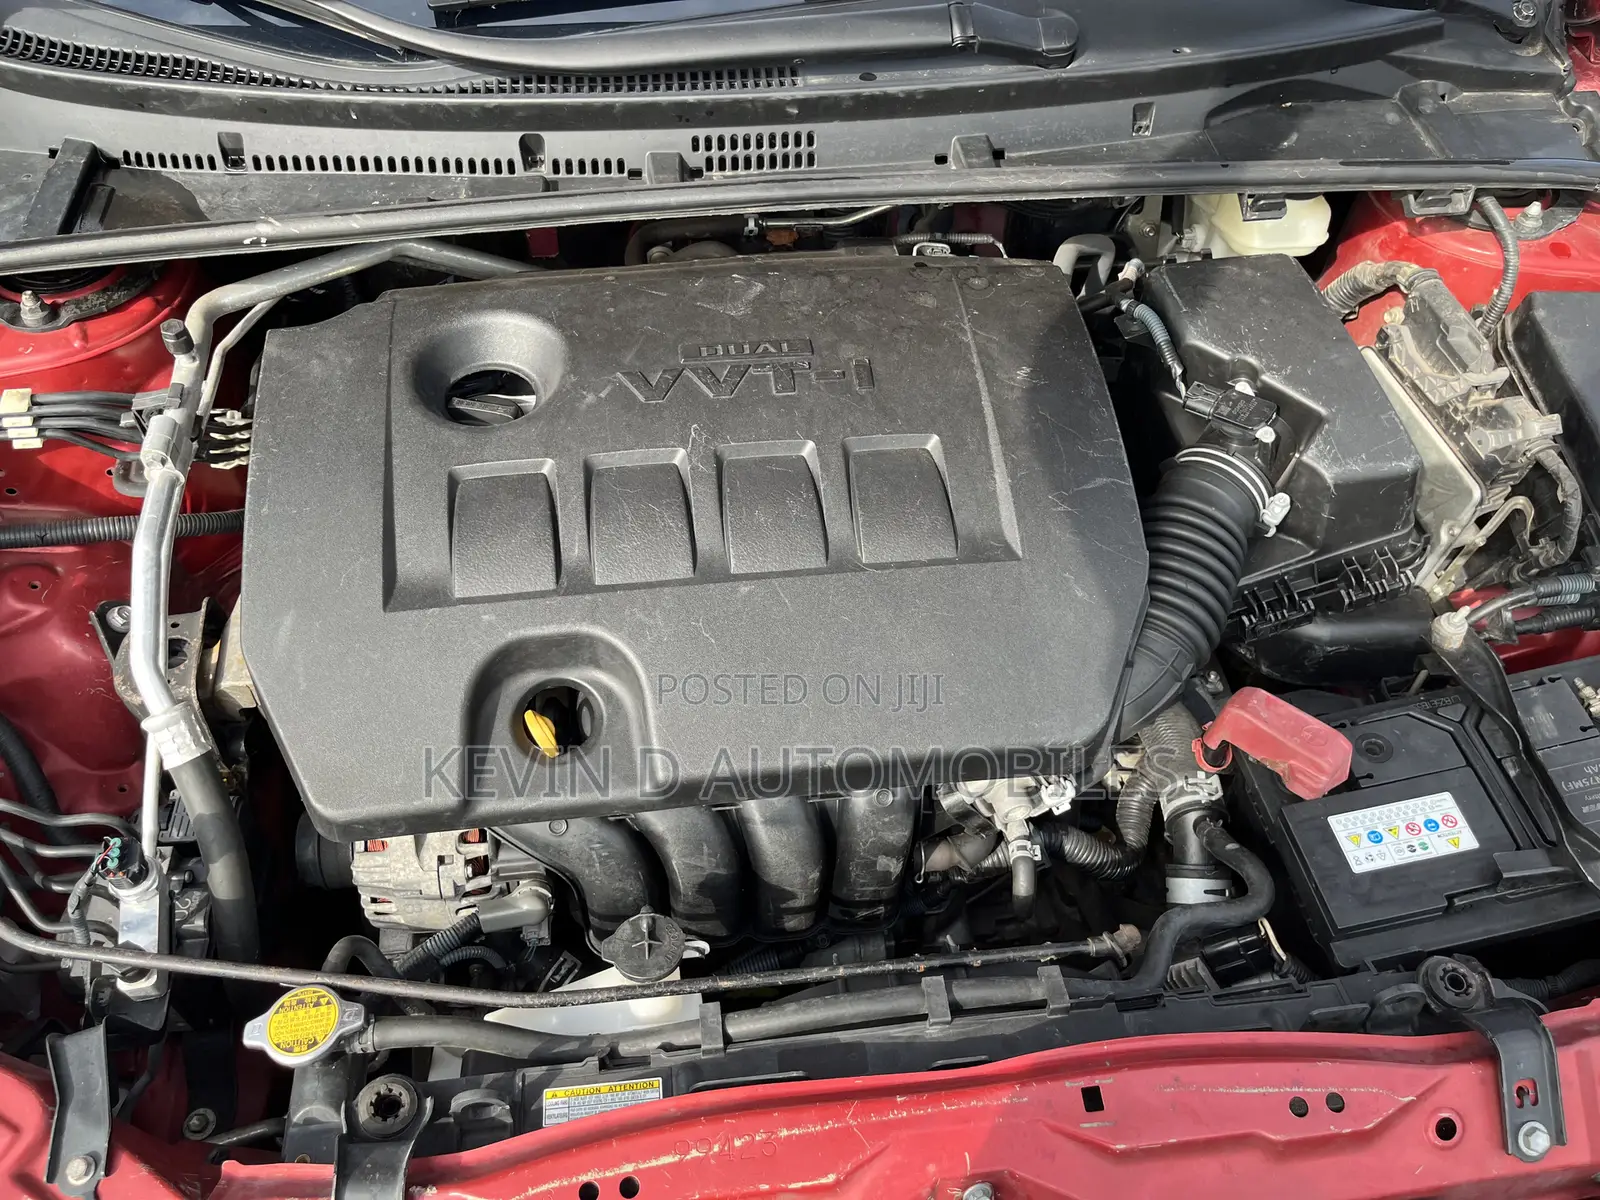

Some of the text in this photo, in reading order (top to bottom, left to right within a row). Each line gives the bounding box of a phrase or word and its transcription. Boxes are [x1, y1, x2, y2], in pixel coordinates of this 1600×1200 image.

[699, 341, 797, 357] DUAL
[280, 1035, 315, 1049] CAUTION
[564, 1087, 601, 1097] CAUTION
[608, 1081, 655, 1093] ATTENTION
[674, 1130, 778, 1163] 99423
